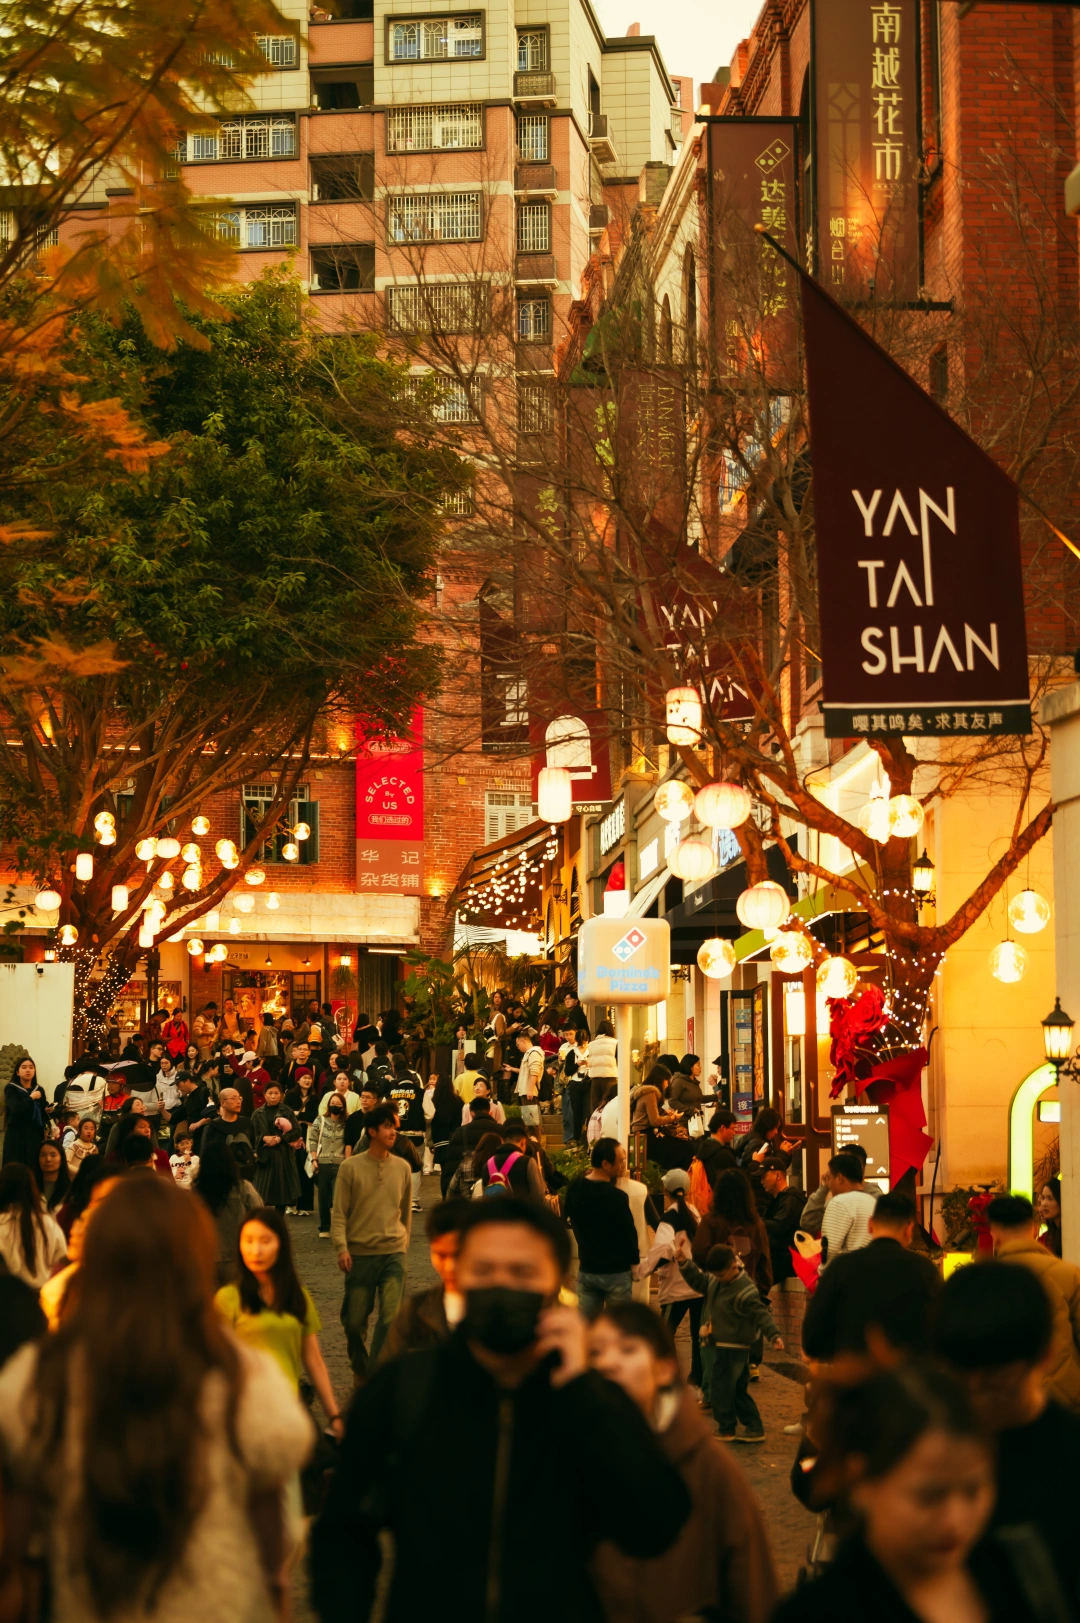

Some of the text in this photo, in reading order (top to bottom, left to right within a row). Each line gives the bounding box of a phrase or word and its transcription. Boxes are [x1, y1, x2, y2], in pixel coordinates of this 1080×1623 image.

[870, 1, 904, 181] 南越花市
[851, 486, 957, 537] YAN
[857, 559, 935, 609] TAI
[861, 622, 1000, 676] SHAN
[365, 776, 415, 805] SELECTED
[384, 790, 395, 799] BY
[382, 801, 398, 810] US
[371, 815, 409, 825] 我们选过的
[360, 872, 420, 888] 杂货铺
[596, 966, 660, 979] Domino's
[609, 979, 648, 992] Pizza
